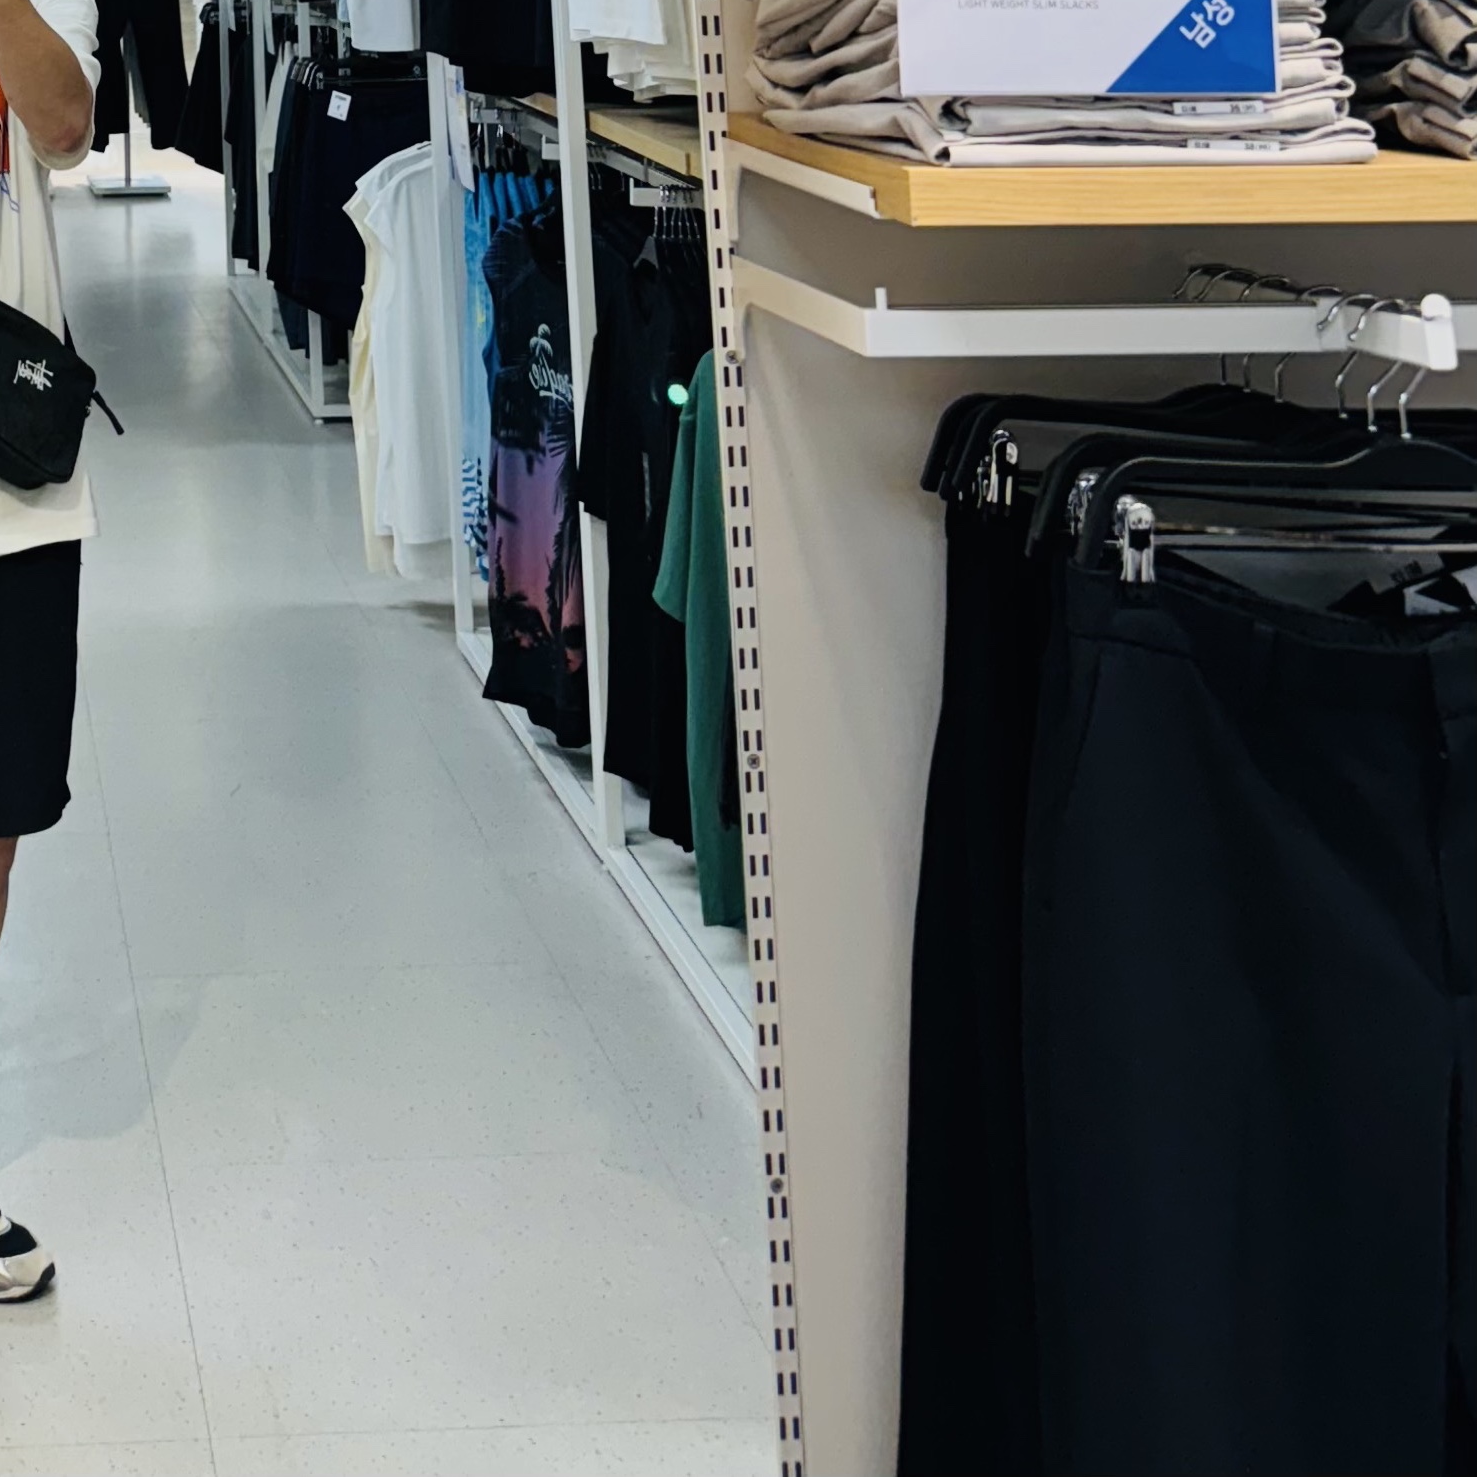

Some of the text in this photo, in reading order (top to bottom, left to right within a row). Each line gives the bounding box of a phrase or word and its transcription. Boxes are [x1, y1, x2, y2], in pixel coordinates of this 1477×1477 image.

[957, 0, 1099, 10] LIGHT WEIGHT SLIM SLACKS
